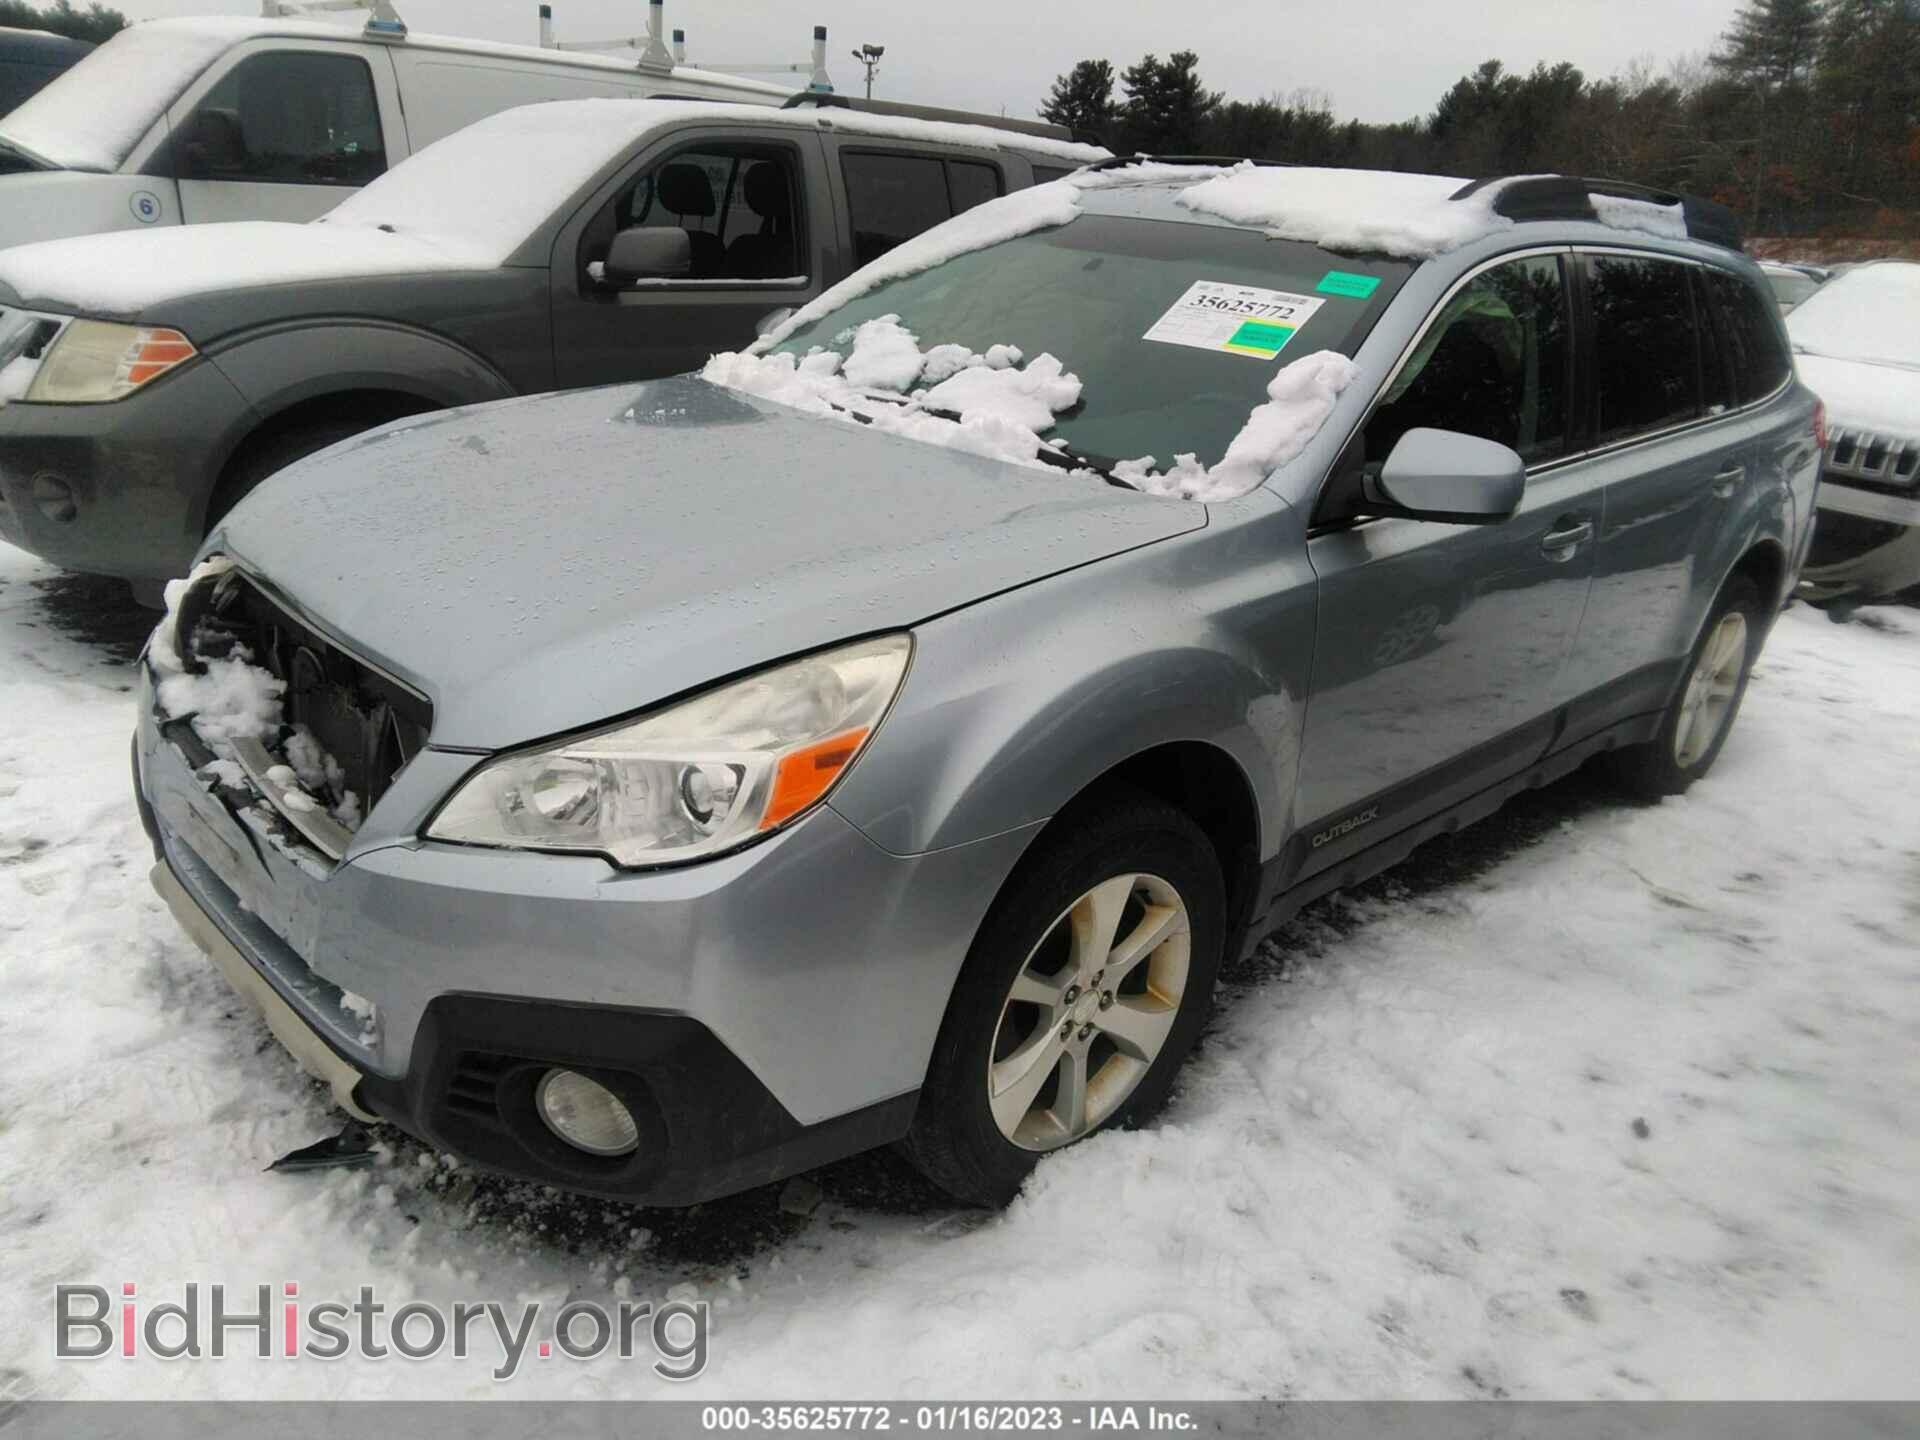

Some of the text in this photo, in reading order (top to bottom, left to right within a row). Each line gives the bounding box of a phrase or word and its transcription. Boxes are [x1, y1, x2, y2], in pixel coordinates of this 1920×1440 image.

[139, 198, 153, 216] 6
[1189, 294, 1295, 320] 35625772
[1311, 805, 1379, 848] OUTBACK
